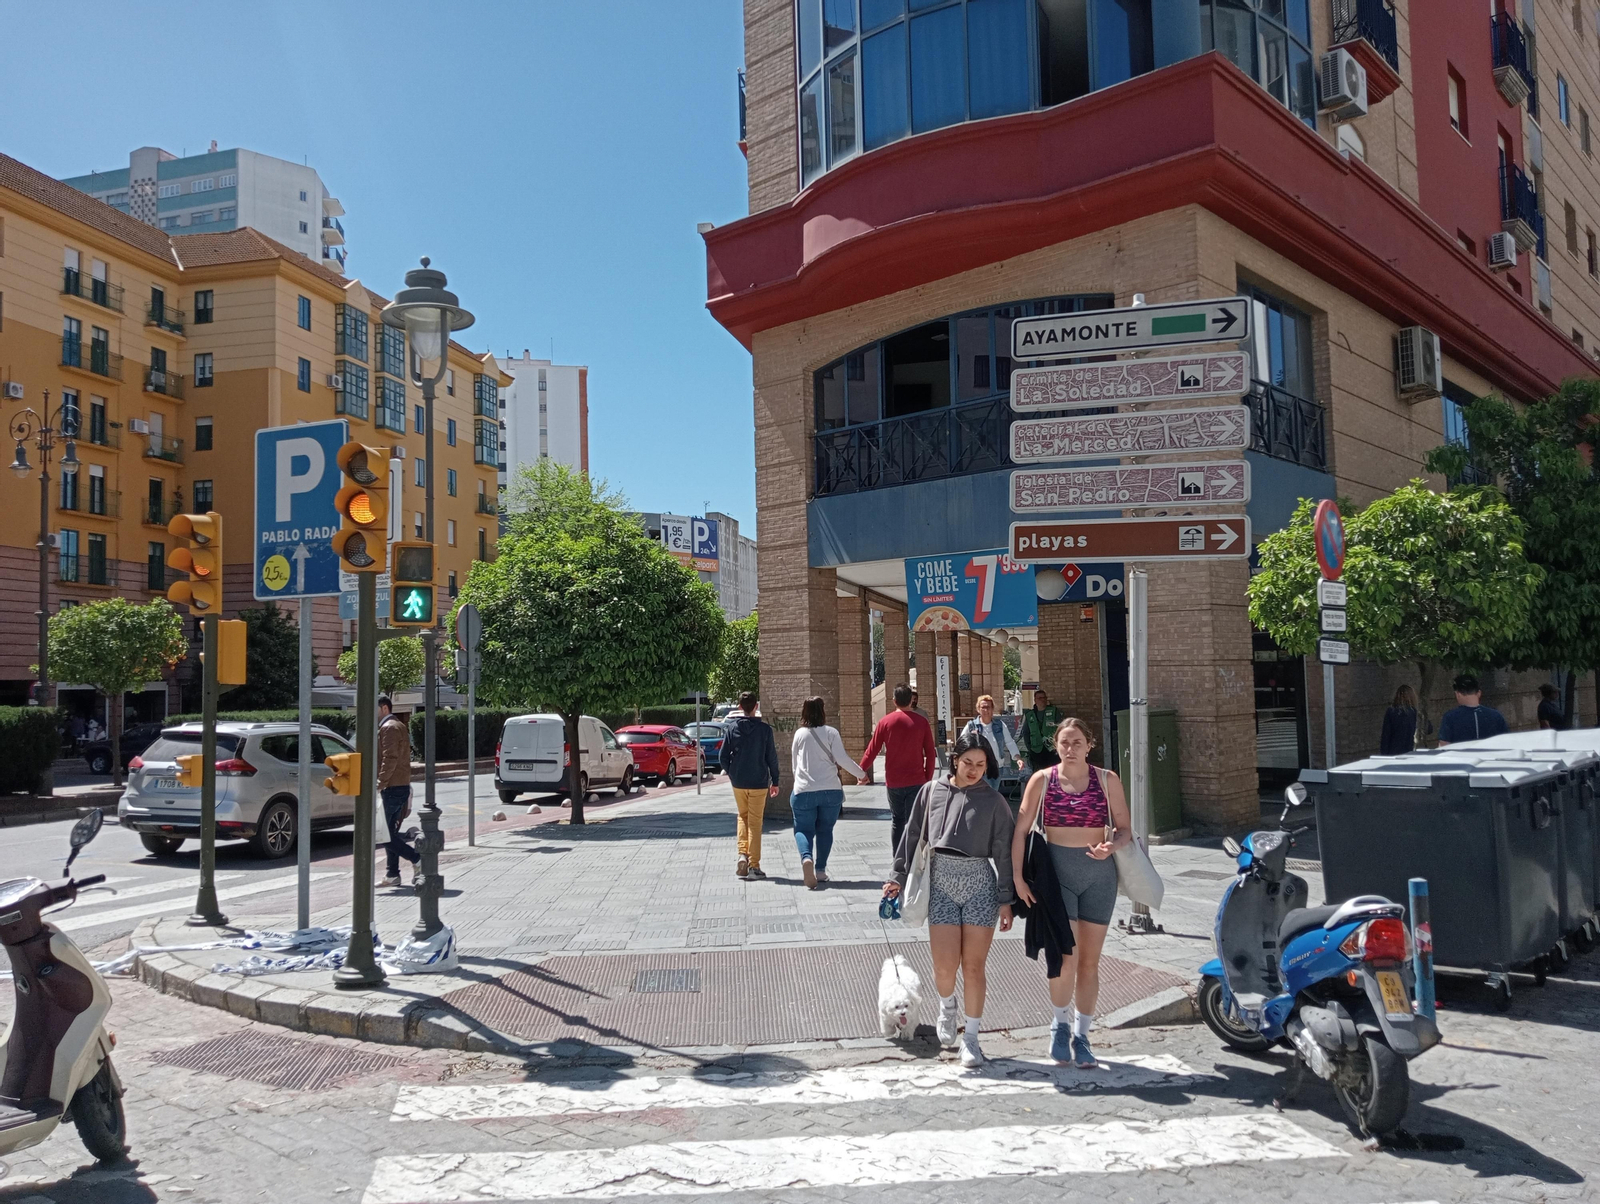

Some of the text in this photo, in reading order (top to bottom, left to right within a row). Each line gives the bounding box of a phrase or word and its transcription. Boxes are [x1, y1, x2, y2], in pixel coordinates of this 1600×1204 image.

[1022, 321, 1138, 346] AYAMONTE
[1021, 370, 1093, 385] ermita de
[1020, 380, 1142, 403] La Soledad
[1018, 421, 1104, 438] catedral de
[1020, 435, 1133, 455] La Merced
[276, 437, 325, 522] P
[1018, 473, 1092, 488] iglesia de
[1020, 487, 1130, 506] San Pedro
[262, 526, 338, 544] PABLO RADA
[693, 521, 710, 553] P
[1018, 533, 1088, 552] playas
[917, 559, 953, 578] COME
[914, 575, 959, 594] Y BEBE
[1086, 575, 1123, 598] Do
[375, 592, 389, 601] ZUL
